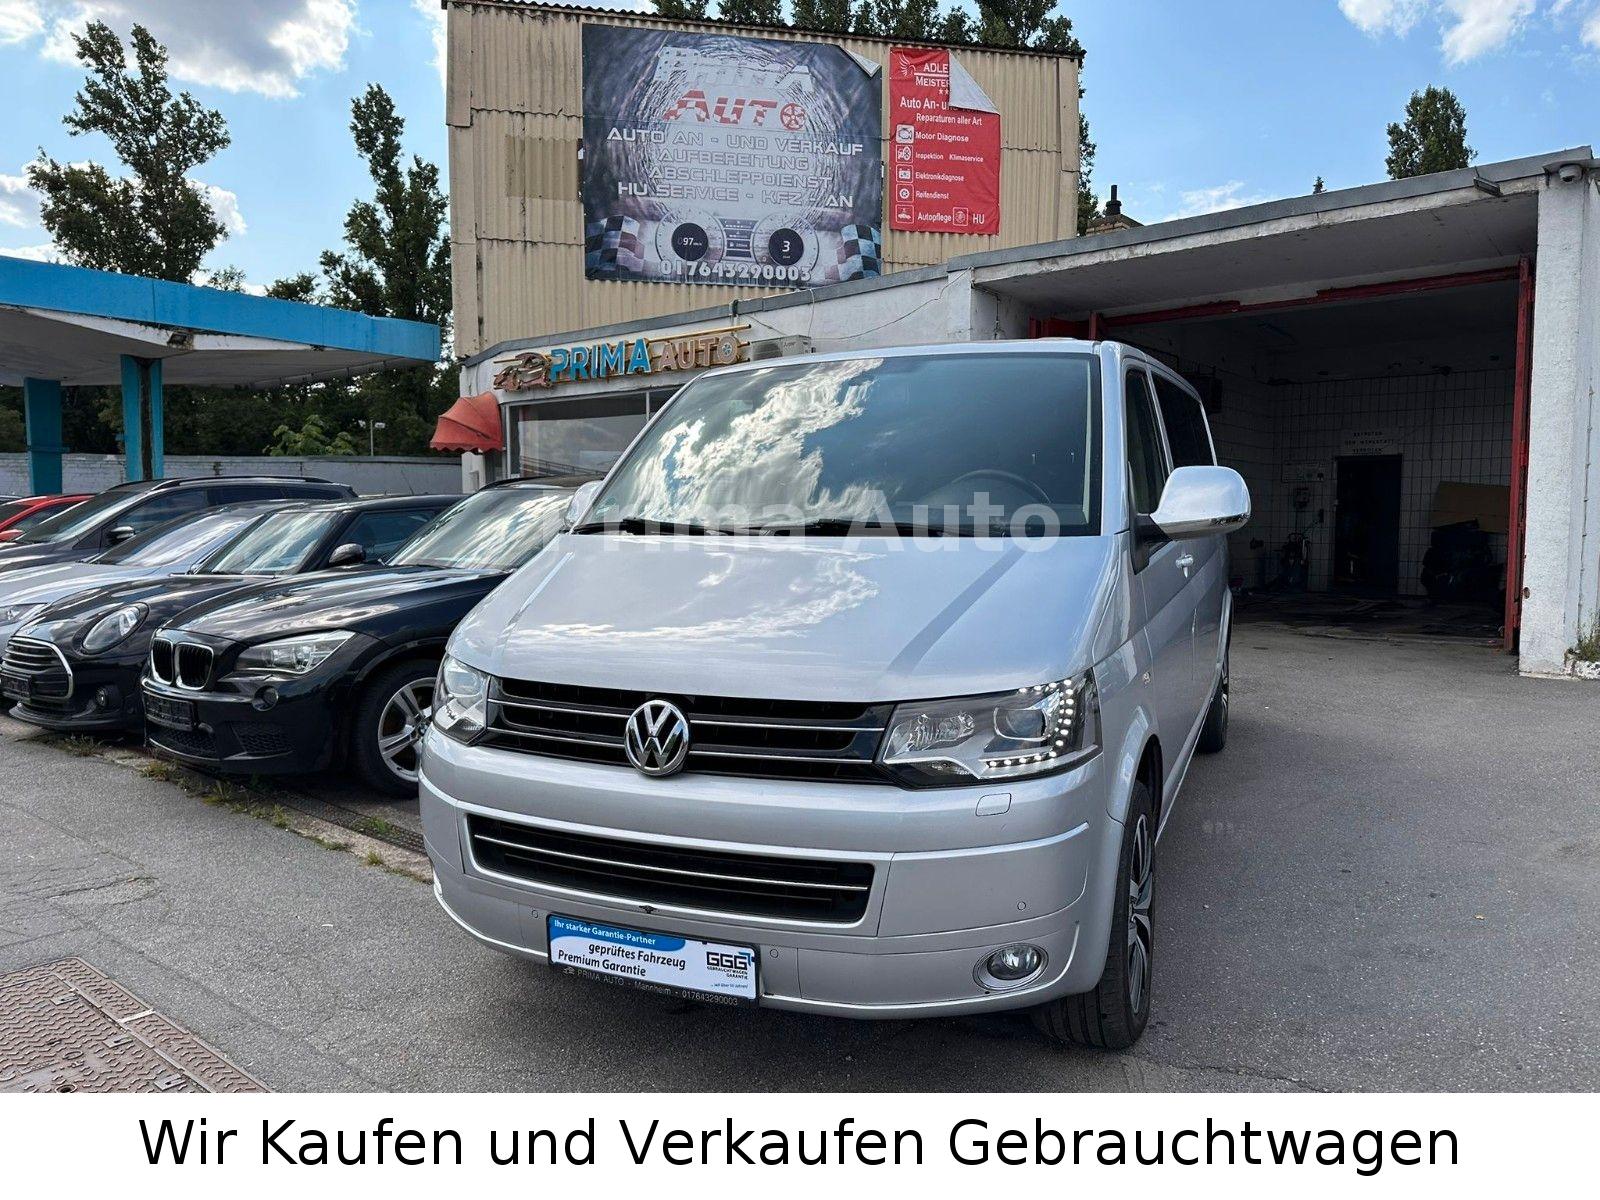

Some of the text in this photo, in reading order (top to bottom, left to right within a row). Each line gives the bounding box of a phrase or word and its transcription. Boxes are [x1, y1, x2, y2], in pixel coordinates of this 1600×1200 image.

[662, 89, 807, 131] AUTO
[899, 96, 922, 109] Auto
[923, 98, 940, 110] An-
[916, 113, 983, 126] Reparaturen aller Art
[606, 127, 665, 143] AUTO
[672, 132, 704, 147] AN
[727, 134, 768, 150] UND
[775, 137, 863, 156] VERKAUF
[915, 132, 969, 143] Motor Diagnose
[659, 149, 809, 171] AUFBEREITUNG
[915, 152, 983, 163] Inspektion Klimaservice
[648, 166, 832, 189] ABSCHLEPPDIENST
[915, 171, 965, 182] Elektronikdiagnose
[618, 181, 648, 196] HU
[656, 183, 739, 201] SERVICE
[762, 190, 802, 206] KFZ
[825, 195, 854, 208] AN
[915, 190, 950, 200] Reifendienst
[917, 212, 952, 223] Autopflege
[972, 213, 985, 225] HU
[660, 260, 812, 282] 017643290003
[549, 333, 740, 383] PRIMA AUTO
[554, 919, 656, 945] Ihr starker Garantie-Partner
[557, 949, 647, 977] Premium Garantie
[588, 942, 686, 971] geprüftes Fahrzeug
[706, 951, 748, 970] GGG
[577, 969, 601, 982] PRIMA
[603, 974, 625, 986] AUTO
[634, 980, 672, 995] Mannheim
